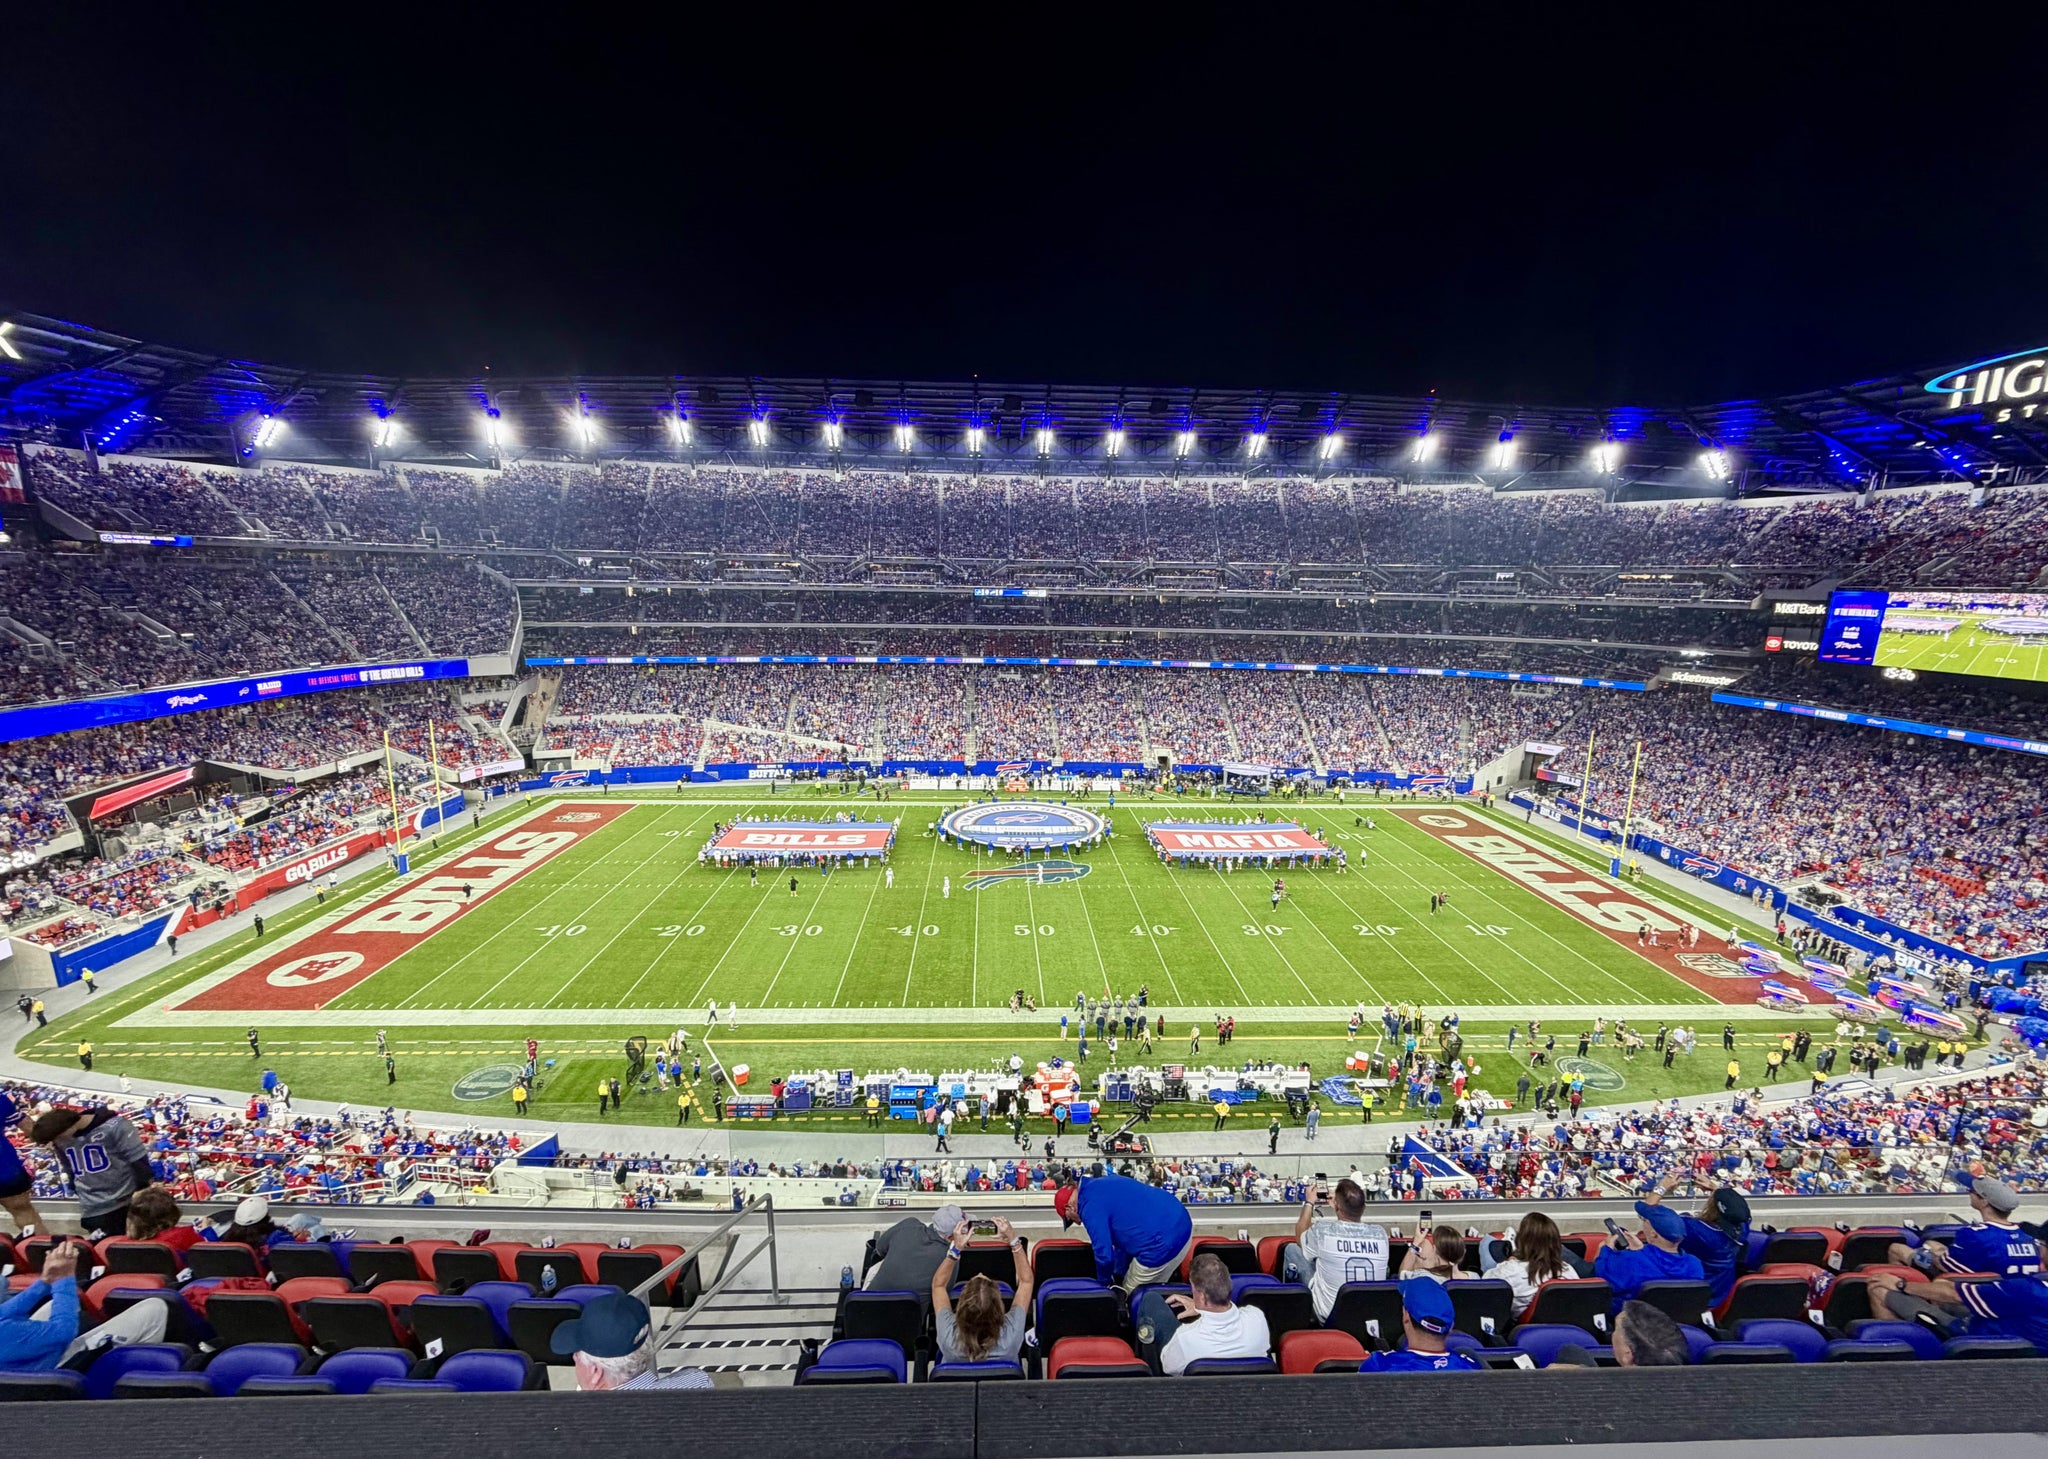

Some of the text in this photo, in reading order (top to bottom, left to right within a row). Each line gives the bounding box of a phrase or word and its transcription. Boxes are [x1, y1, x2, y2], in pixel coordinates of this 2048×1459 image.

[1950, 359, 2048, 409] HIG
[1996, 404, 2048, 422] ST
[1774, 602, 1828, 615] M&T Bank
[256, 681, 282, 691] RADIO
[748, 768, 793, 779] BUFFALO
[1540, 806, 1561, 822] BILLS
[741, 833, 867, 846] BILLS
[1175, 834, 1302, 848] MAFIA
[307, 845, 349, 873] BILLS
[333, 831, 579, 934] BILLS
[1441, 834, 1683, 934] BILLS
[540, 924, 587, 937] 10
[657, 924, 706, 937] 20
[778, 924, 823, 937] 30
[897, 924, 940, 937] 40
[1013, 924, 1055, 937] 50
[1129, 924, 1171, 937] 40
[1241, 924, 1284, 937] 30
[1352, 924, 1396, 937] 20
[1465, 924, 1508, 937] 10
[65, 1143, 112, 1177] 10
[1336, 1239, 1380, 1255] COLEMAN
[2006, 1243, 2038, 1257] ALLEN
[1344, 1256, 1375, 1282] 0
